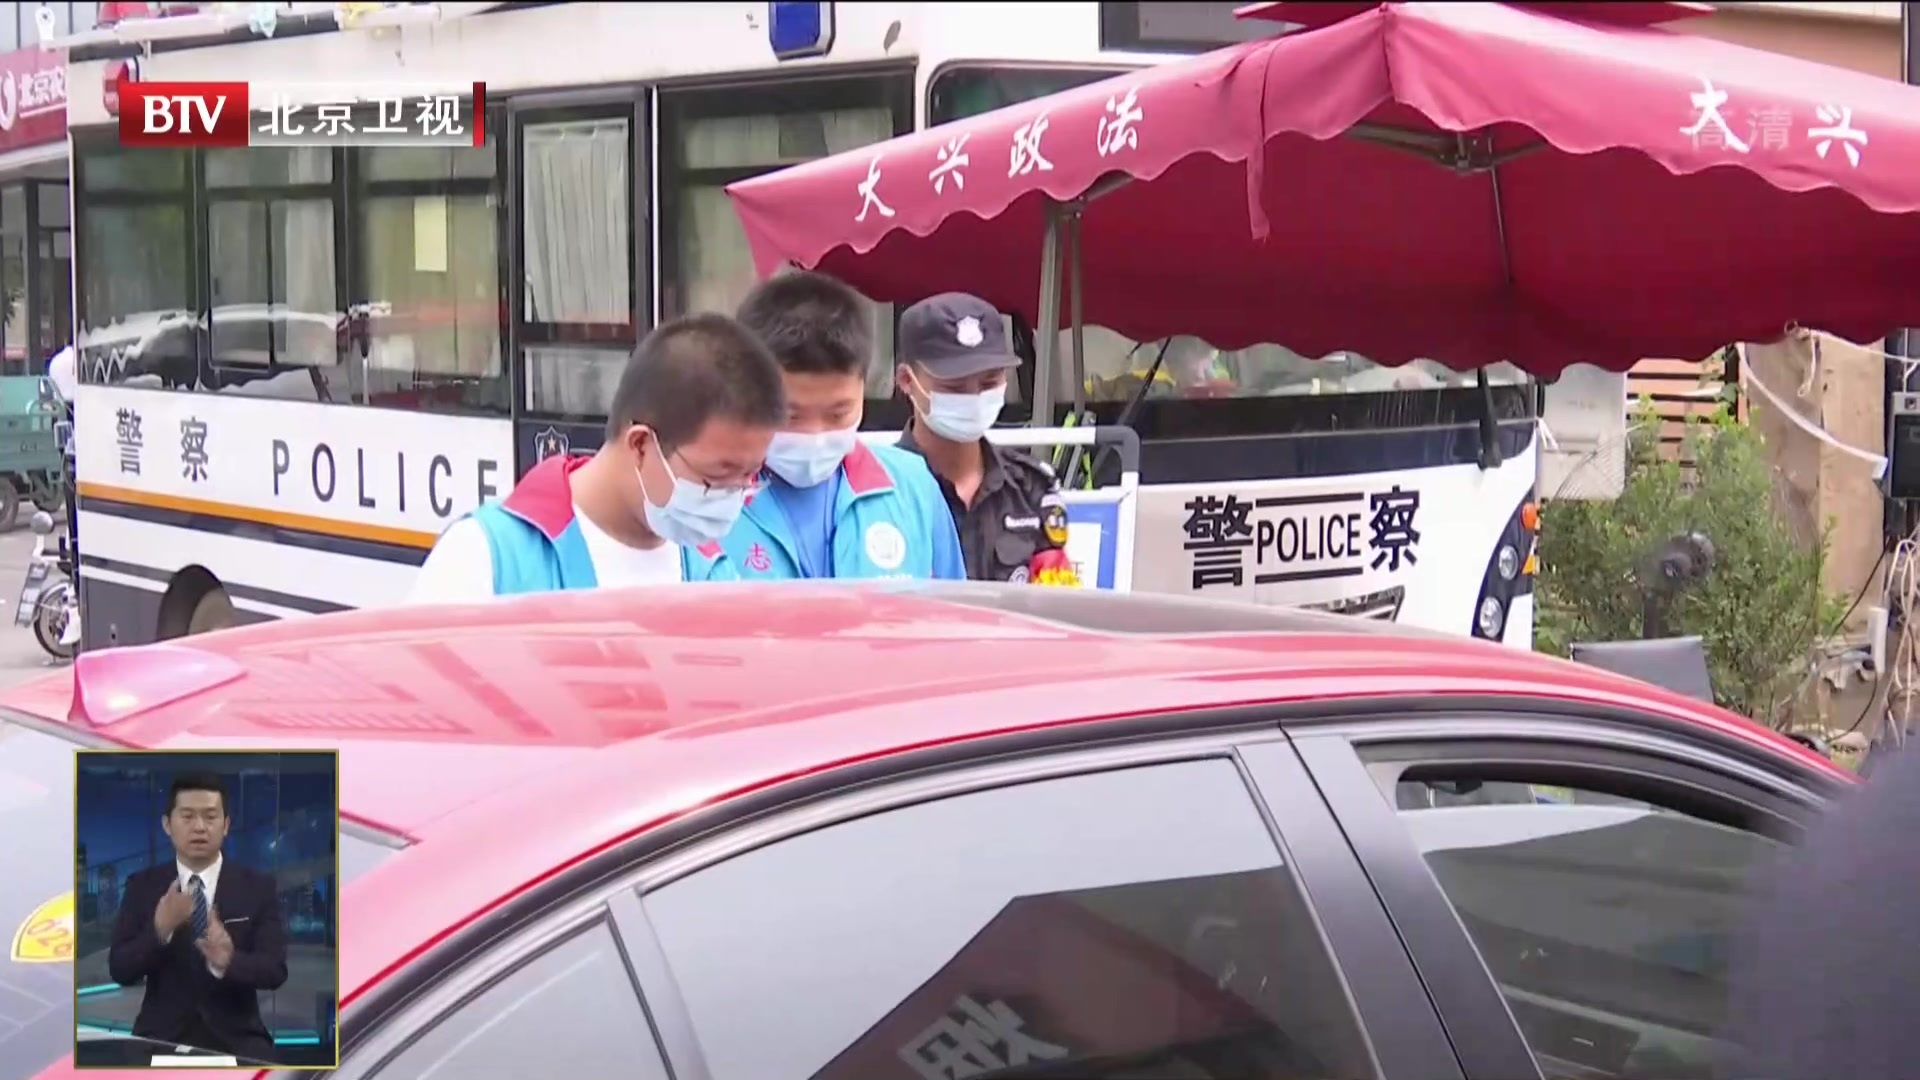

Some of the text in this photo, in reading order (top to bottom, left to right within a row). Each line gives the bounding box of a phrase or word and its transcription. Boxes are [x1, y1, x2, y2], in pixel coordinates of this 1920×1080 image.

[854, 93, 1144, 222] 大兴政法
[1679, 72, 1868, 168] 大兴
[115, 408, 208, 482] 警察
[744, 543, 772, 572] 志
[1183, 484, 1421, 590] 警 POLICE 察
